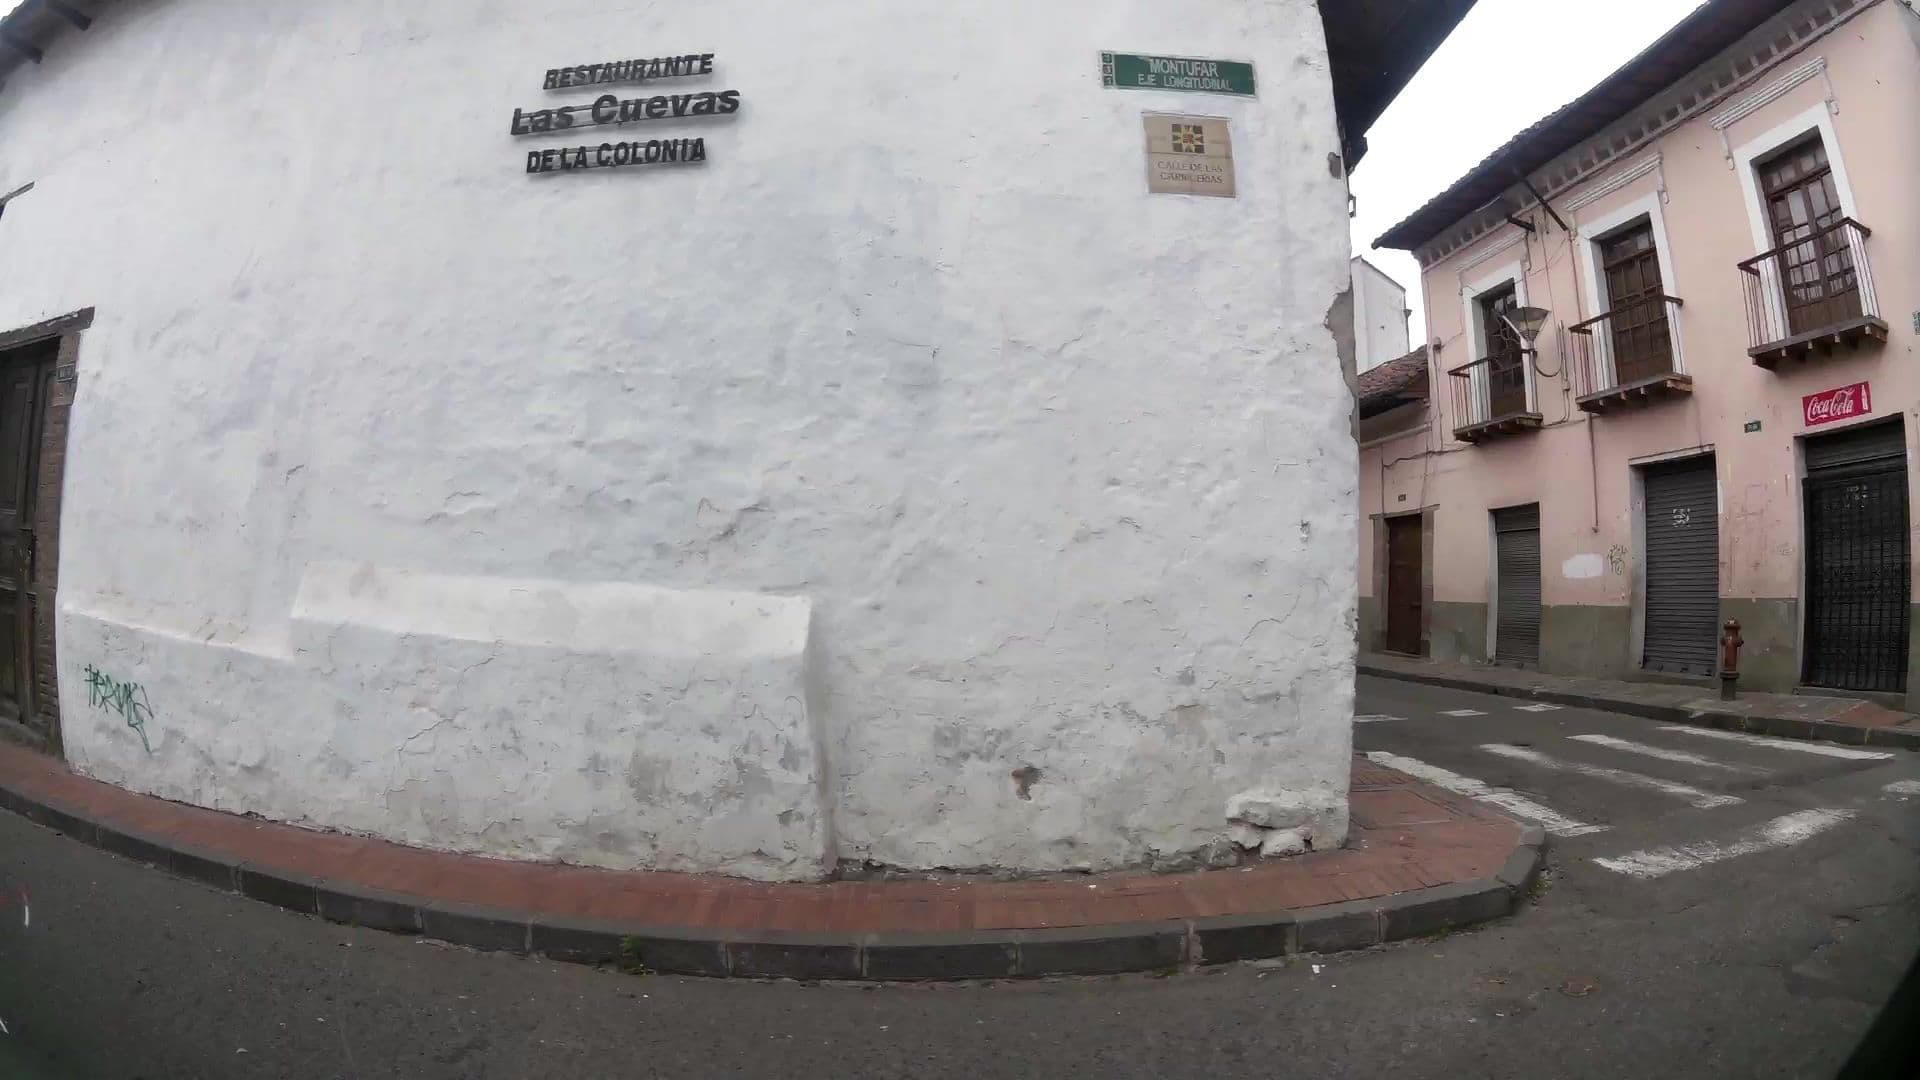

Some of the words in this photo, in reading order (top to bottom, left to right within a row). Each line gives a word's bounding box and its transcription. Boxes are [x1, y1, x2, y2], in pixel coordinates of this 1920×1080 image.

[542, 53, 715, 90] RESTAURANTE
[1138, 74, 1157, 86] EJE
[1150, 58, 1219, 77] MONTUFAR
[510, 107, 574, 135] Las
[591, 90, 741, 124] Cuevas
[527, 149, 555, 174] DE
[560, 145, 589, 169] LA
[597, 138, 707, 166] COLONIA
[1158, 161, 1188, 171] CALLE
